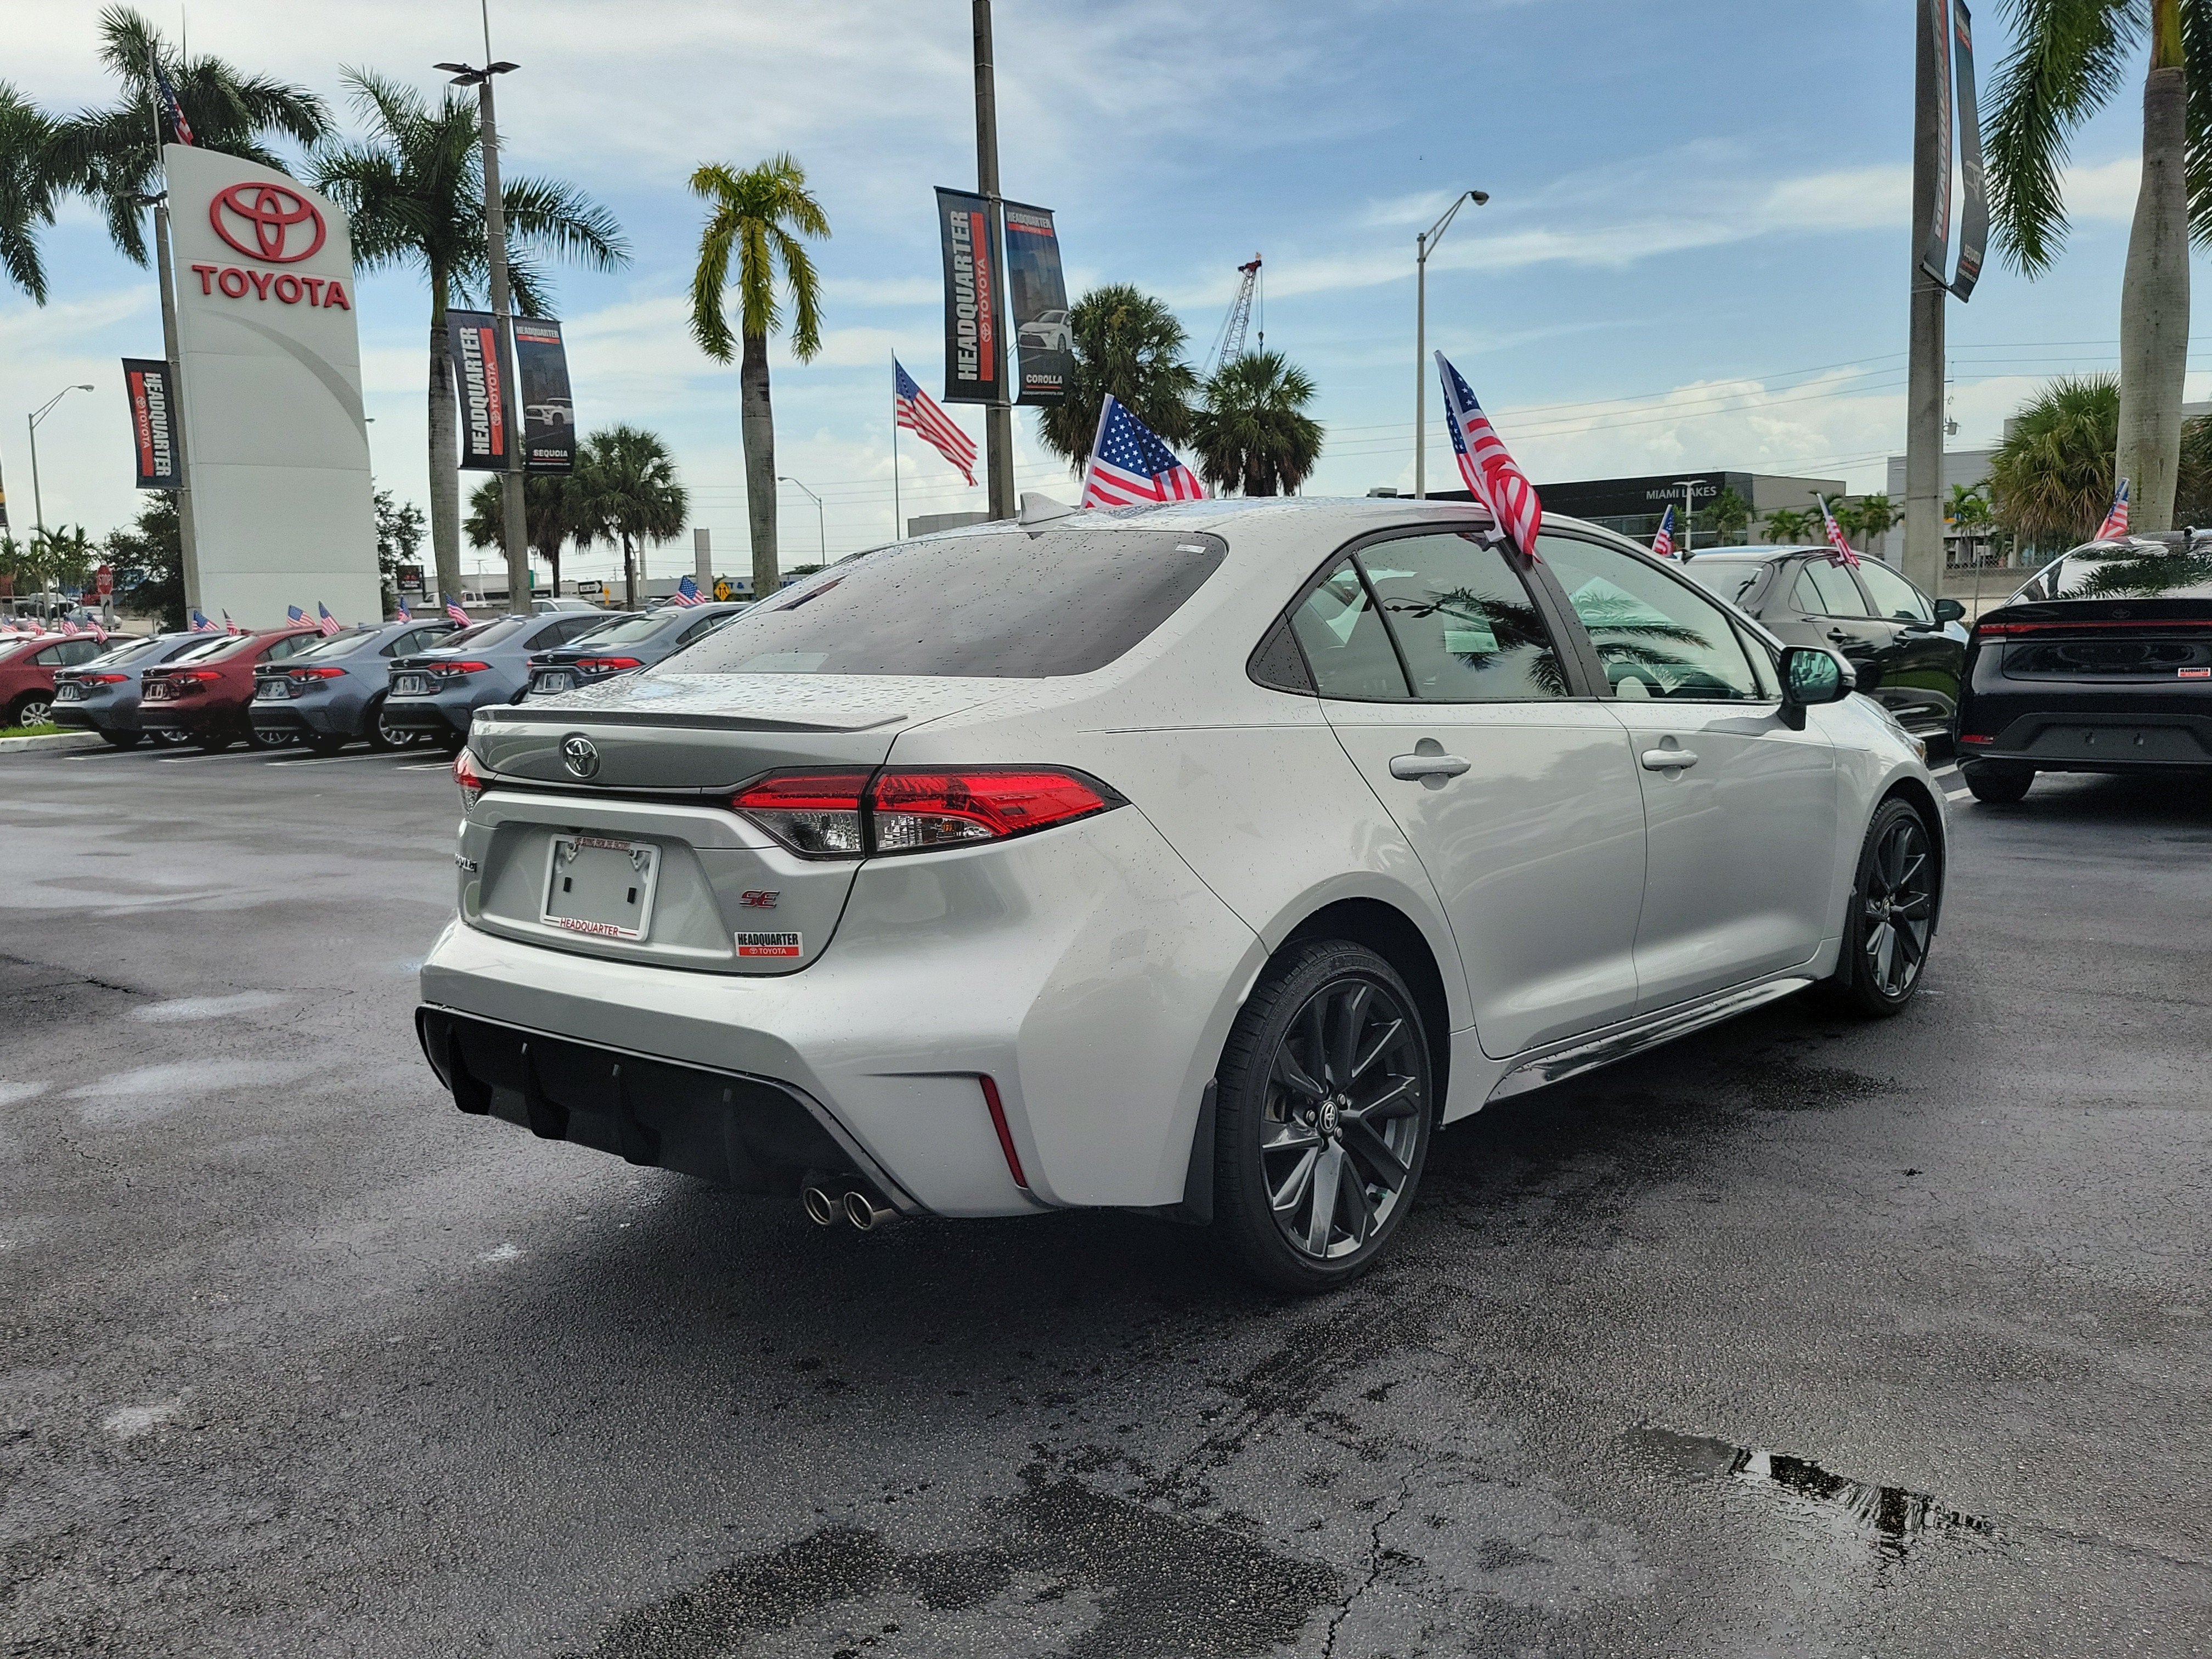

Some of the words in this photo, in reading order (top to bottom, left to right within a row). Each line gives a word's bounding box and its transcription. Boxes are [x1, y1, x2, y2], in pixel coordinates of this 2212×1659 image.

[192, 264, 351, 311] TOYOTA
[950, 211, 978, 380] HEADQUARTER
[977, 258, 989, 320] TOYOTA
[460, 328, 490, 455] HEADQUARTER
[486, 362, 499, 409] TOYOTA
[1026, 374, 1063, 384] COROLLA
[140, 409, 150, 448] TOYOTA
[145, 372, 172, 476] HEADQUARTER
[533, 449, 568, 458] SEQUOIA
[1646, 489, 1679, 500] MIAMI
[1681, 486, 1717, 497] LAKES
[98, 574, 111, 585] STOP
[740, 889, 780, 908] SE
[560, 918, 619, 936] HEADQUARTER
[738, 933, 799, 946] HEADQUARTER
